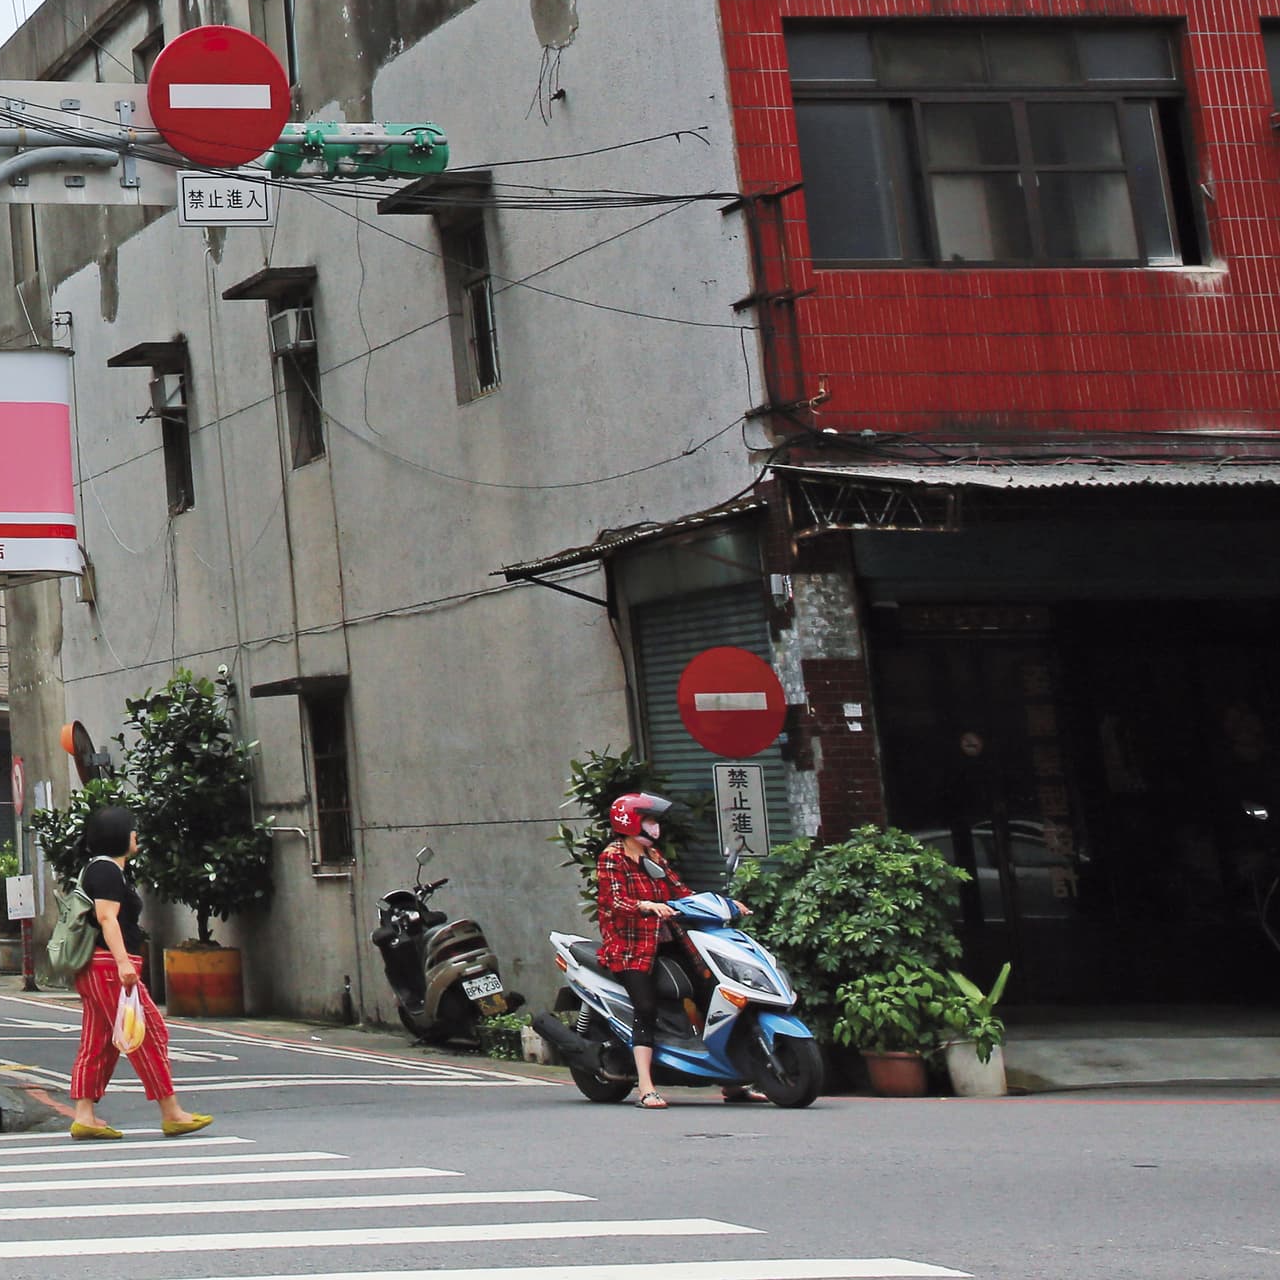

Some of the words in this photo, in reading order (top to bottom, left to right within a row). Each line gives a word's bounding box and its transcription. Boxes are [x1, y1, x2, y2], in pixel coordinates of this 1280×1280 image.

[188, 189, 263, 209] 禁止進入
[727, 768, 754, 854] 禁止進入
